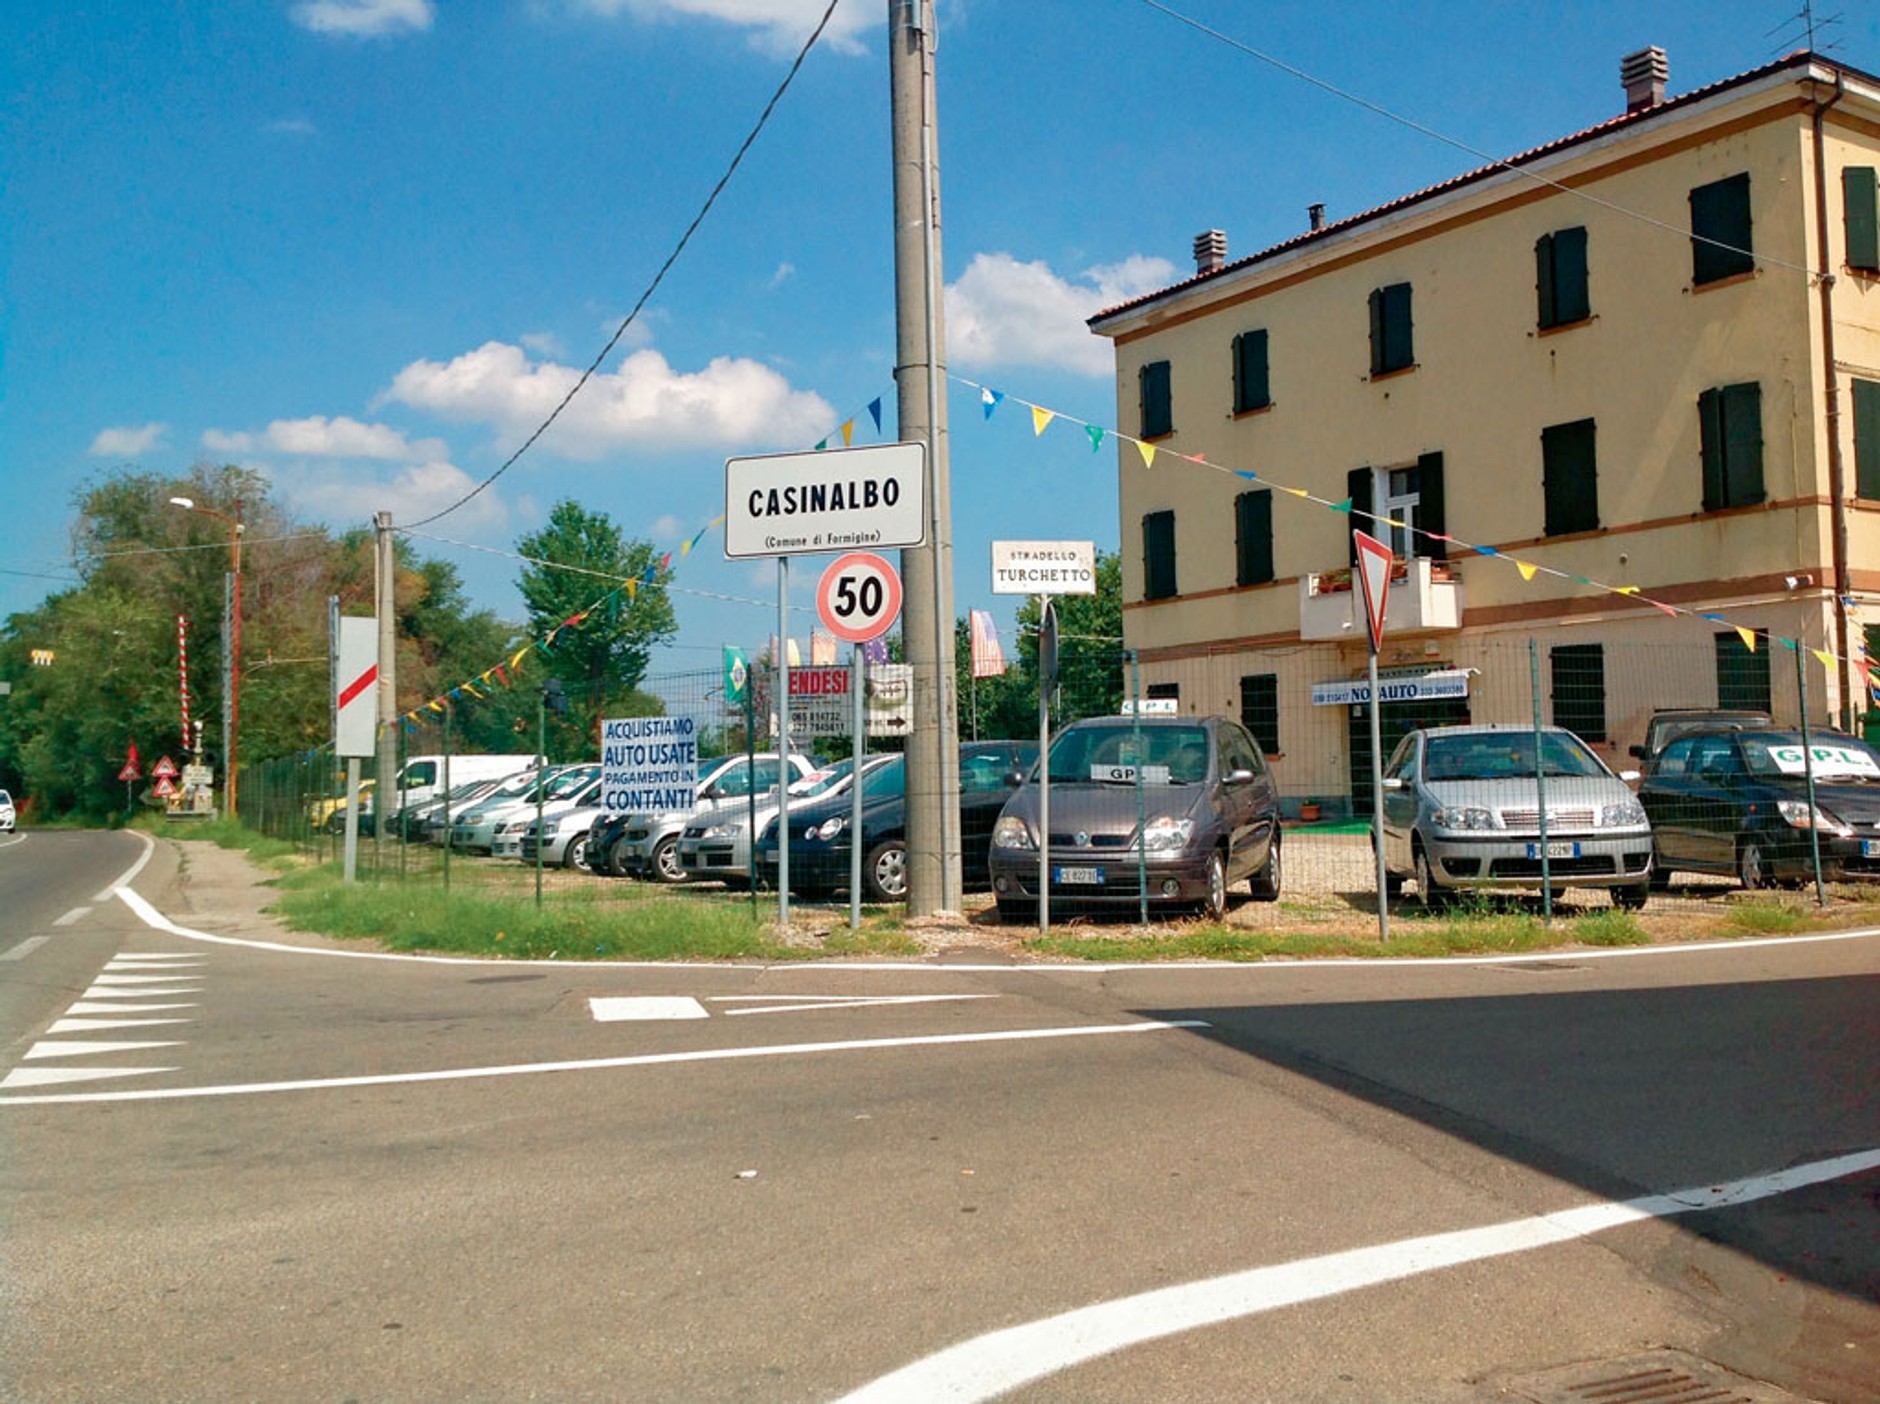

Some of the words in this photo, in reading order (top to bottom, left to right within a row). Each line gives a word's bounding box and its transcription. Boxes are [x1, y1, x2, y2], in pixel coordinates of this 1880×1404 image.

[749, 478, 899, 517] CASINALBO
[765, 534, 807, 549] (Comune
[813, 533, 822, 545] di
[827, 530, 881, 545] Formigine)
[1010, 551, 1077, 561] STRADELLO
[997, 568, 1091, 582] TURCHETTO
[834, 575, 883, 618] 50
[778, 670, 849, 695] ENDESI
[1351, 684, 1418, 702] NOAUTO
[606, 718, 693, 740] ACQUISTIAMO
[604, 745, 646, 767] AUTO
[649, 742, 695, 765] USATE
[605, 770, 679, 785] PAGAMENTO
[681, 769, 694, 783] IN
[606, 788, 693, 810] CONTANTI
